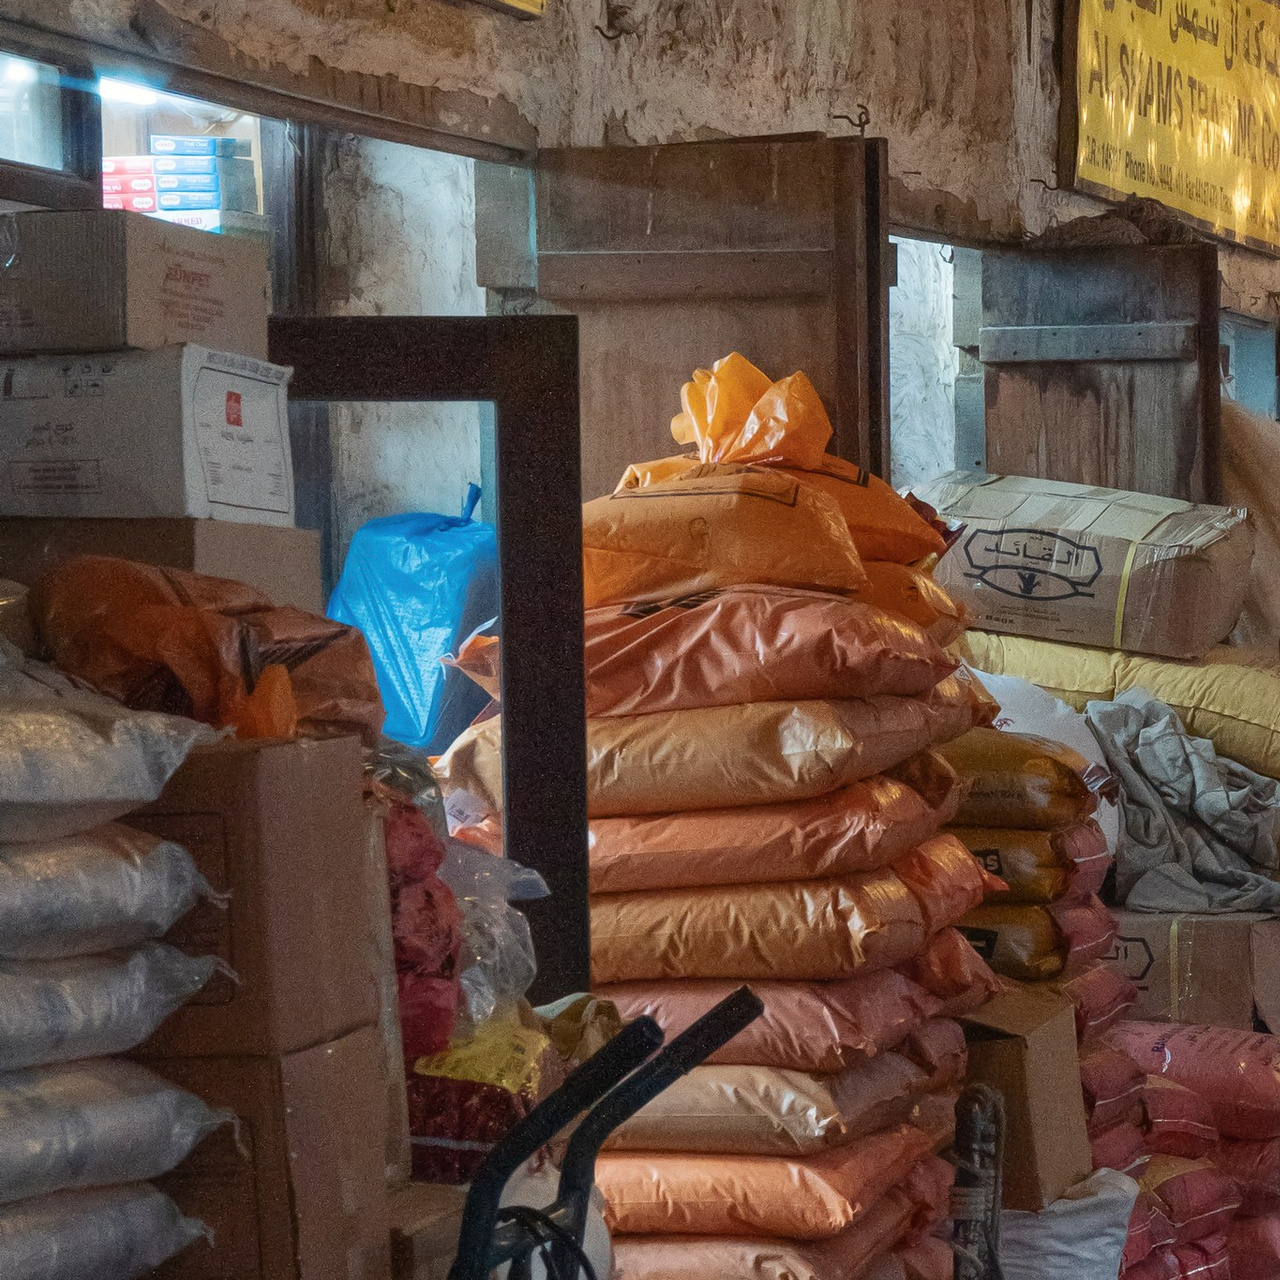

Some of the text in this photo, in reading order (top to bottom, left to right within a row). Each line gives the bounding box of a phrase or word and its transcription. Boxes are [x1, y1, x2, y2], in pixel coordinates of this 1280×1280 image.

[1119, 42, 1184, 132] SHAMS
[1187, 74, 1257, 164] TRAING
[984, 540, 1080, 567] القائد
